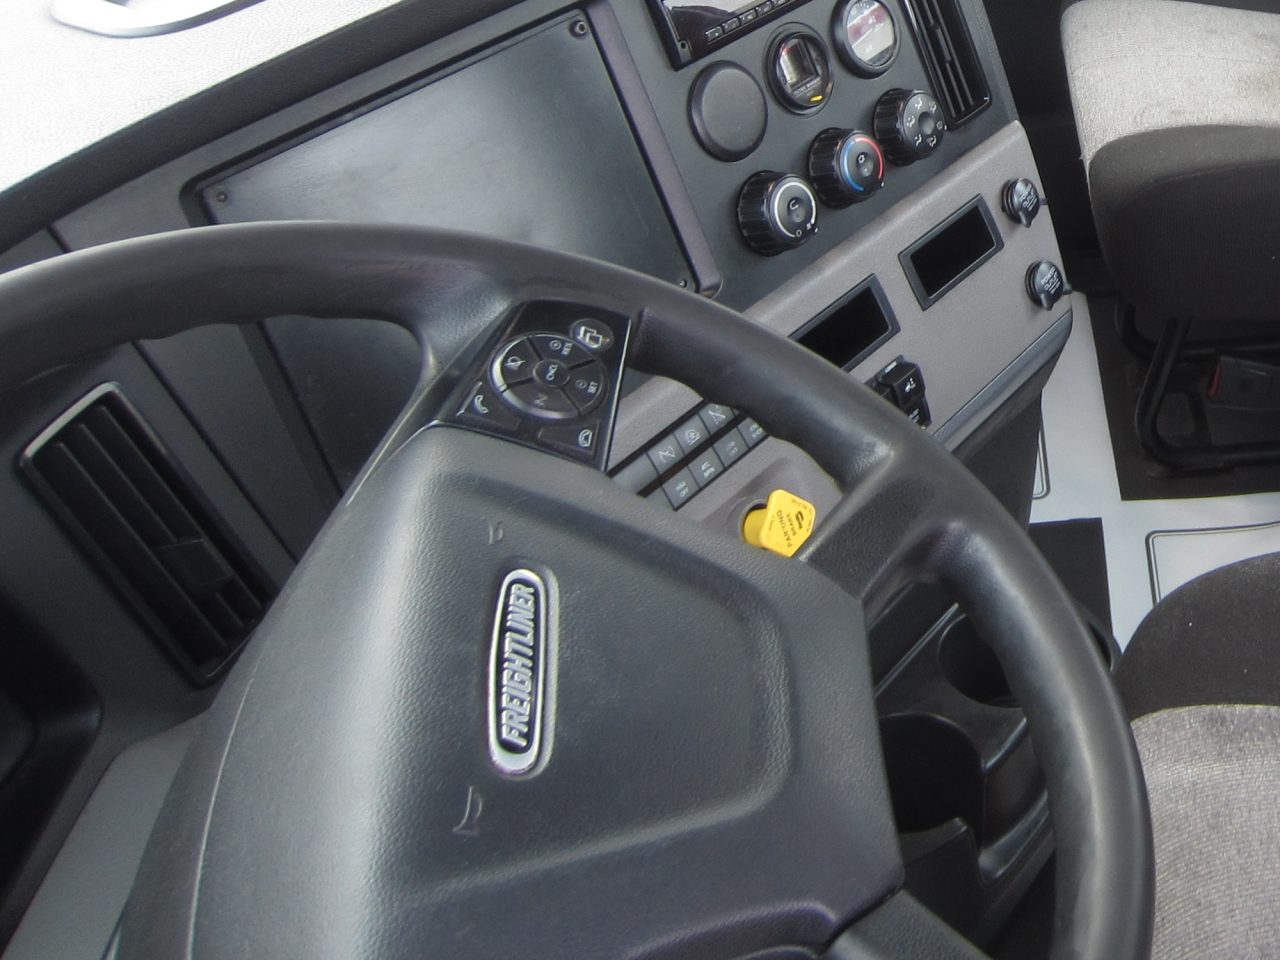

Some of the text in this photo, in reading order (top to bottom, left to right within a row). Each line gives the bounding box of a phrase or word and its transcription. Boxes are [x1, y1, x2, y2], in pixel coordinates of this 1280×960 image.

[1040, 265, 1055, 285] POWER
[1043, 271, 1058, 290] OUTLET
[561, 341, 572, 356] RES
[587, 381, 599, 394] SET
[501, 583, 536, 748] FREIGHTLINER
